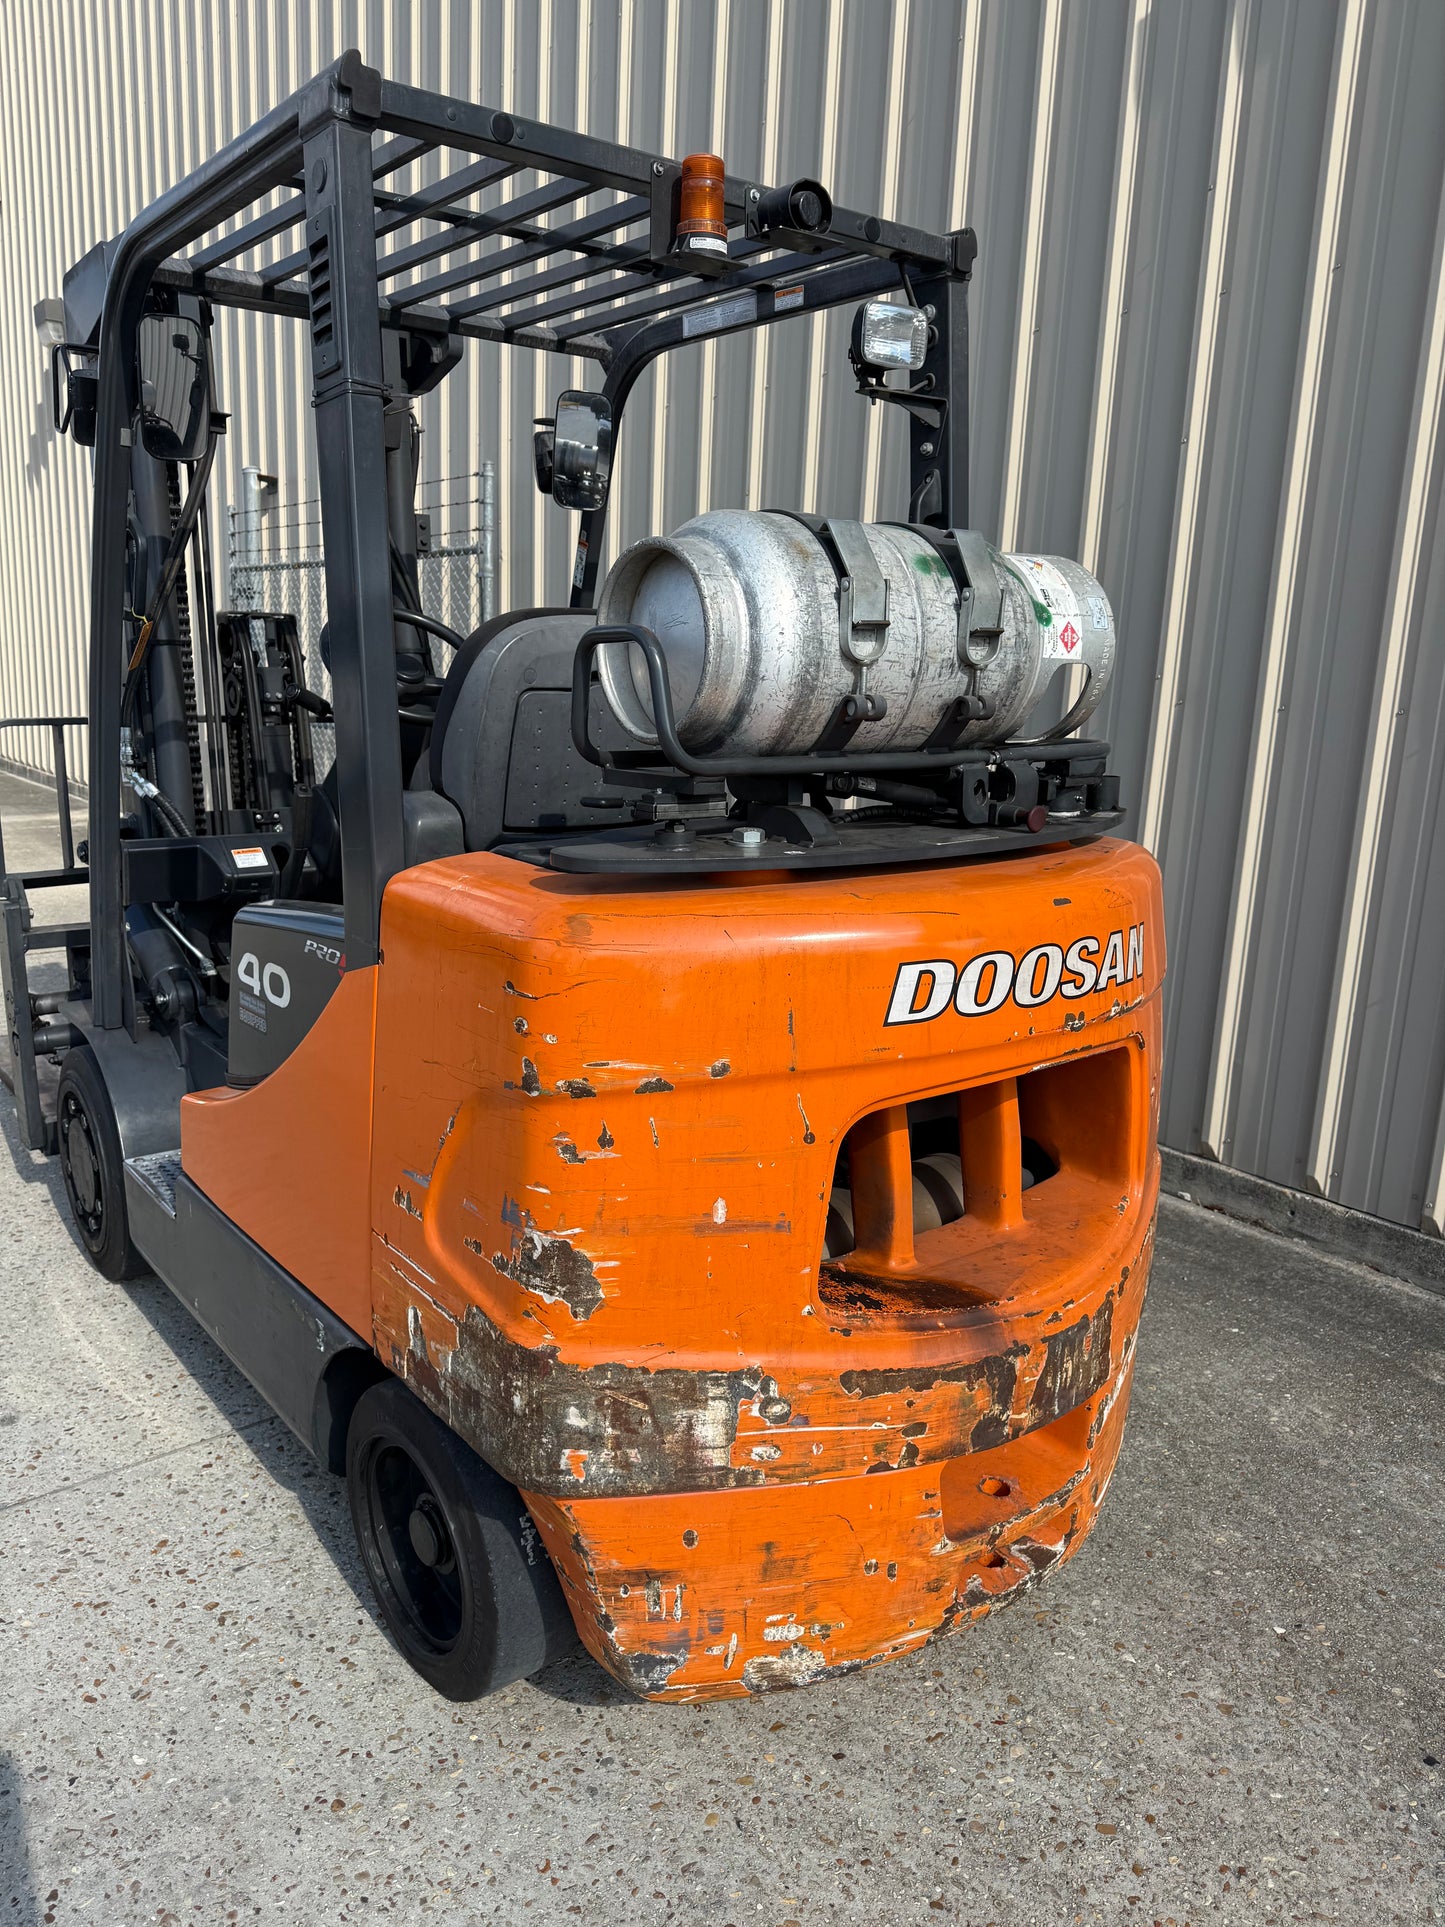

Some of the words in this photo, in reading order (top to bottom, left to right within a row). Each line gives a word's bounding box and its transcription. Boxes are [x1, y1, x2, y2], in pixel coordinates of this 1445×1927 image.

[1101, 638, 1110, 665] MADE
[1098, 669, 1106, 679] IN
[238, 952, 291, 1009] 40
[883, 922, 1144, 1027] DOOSAN
